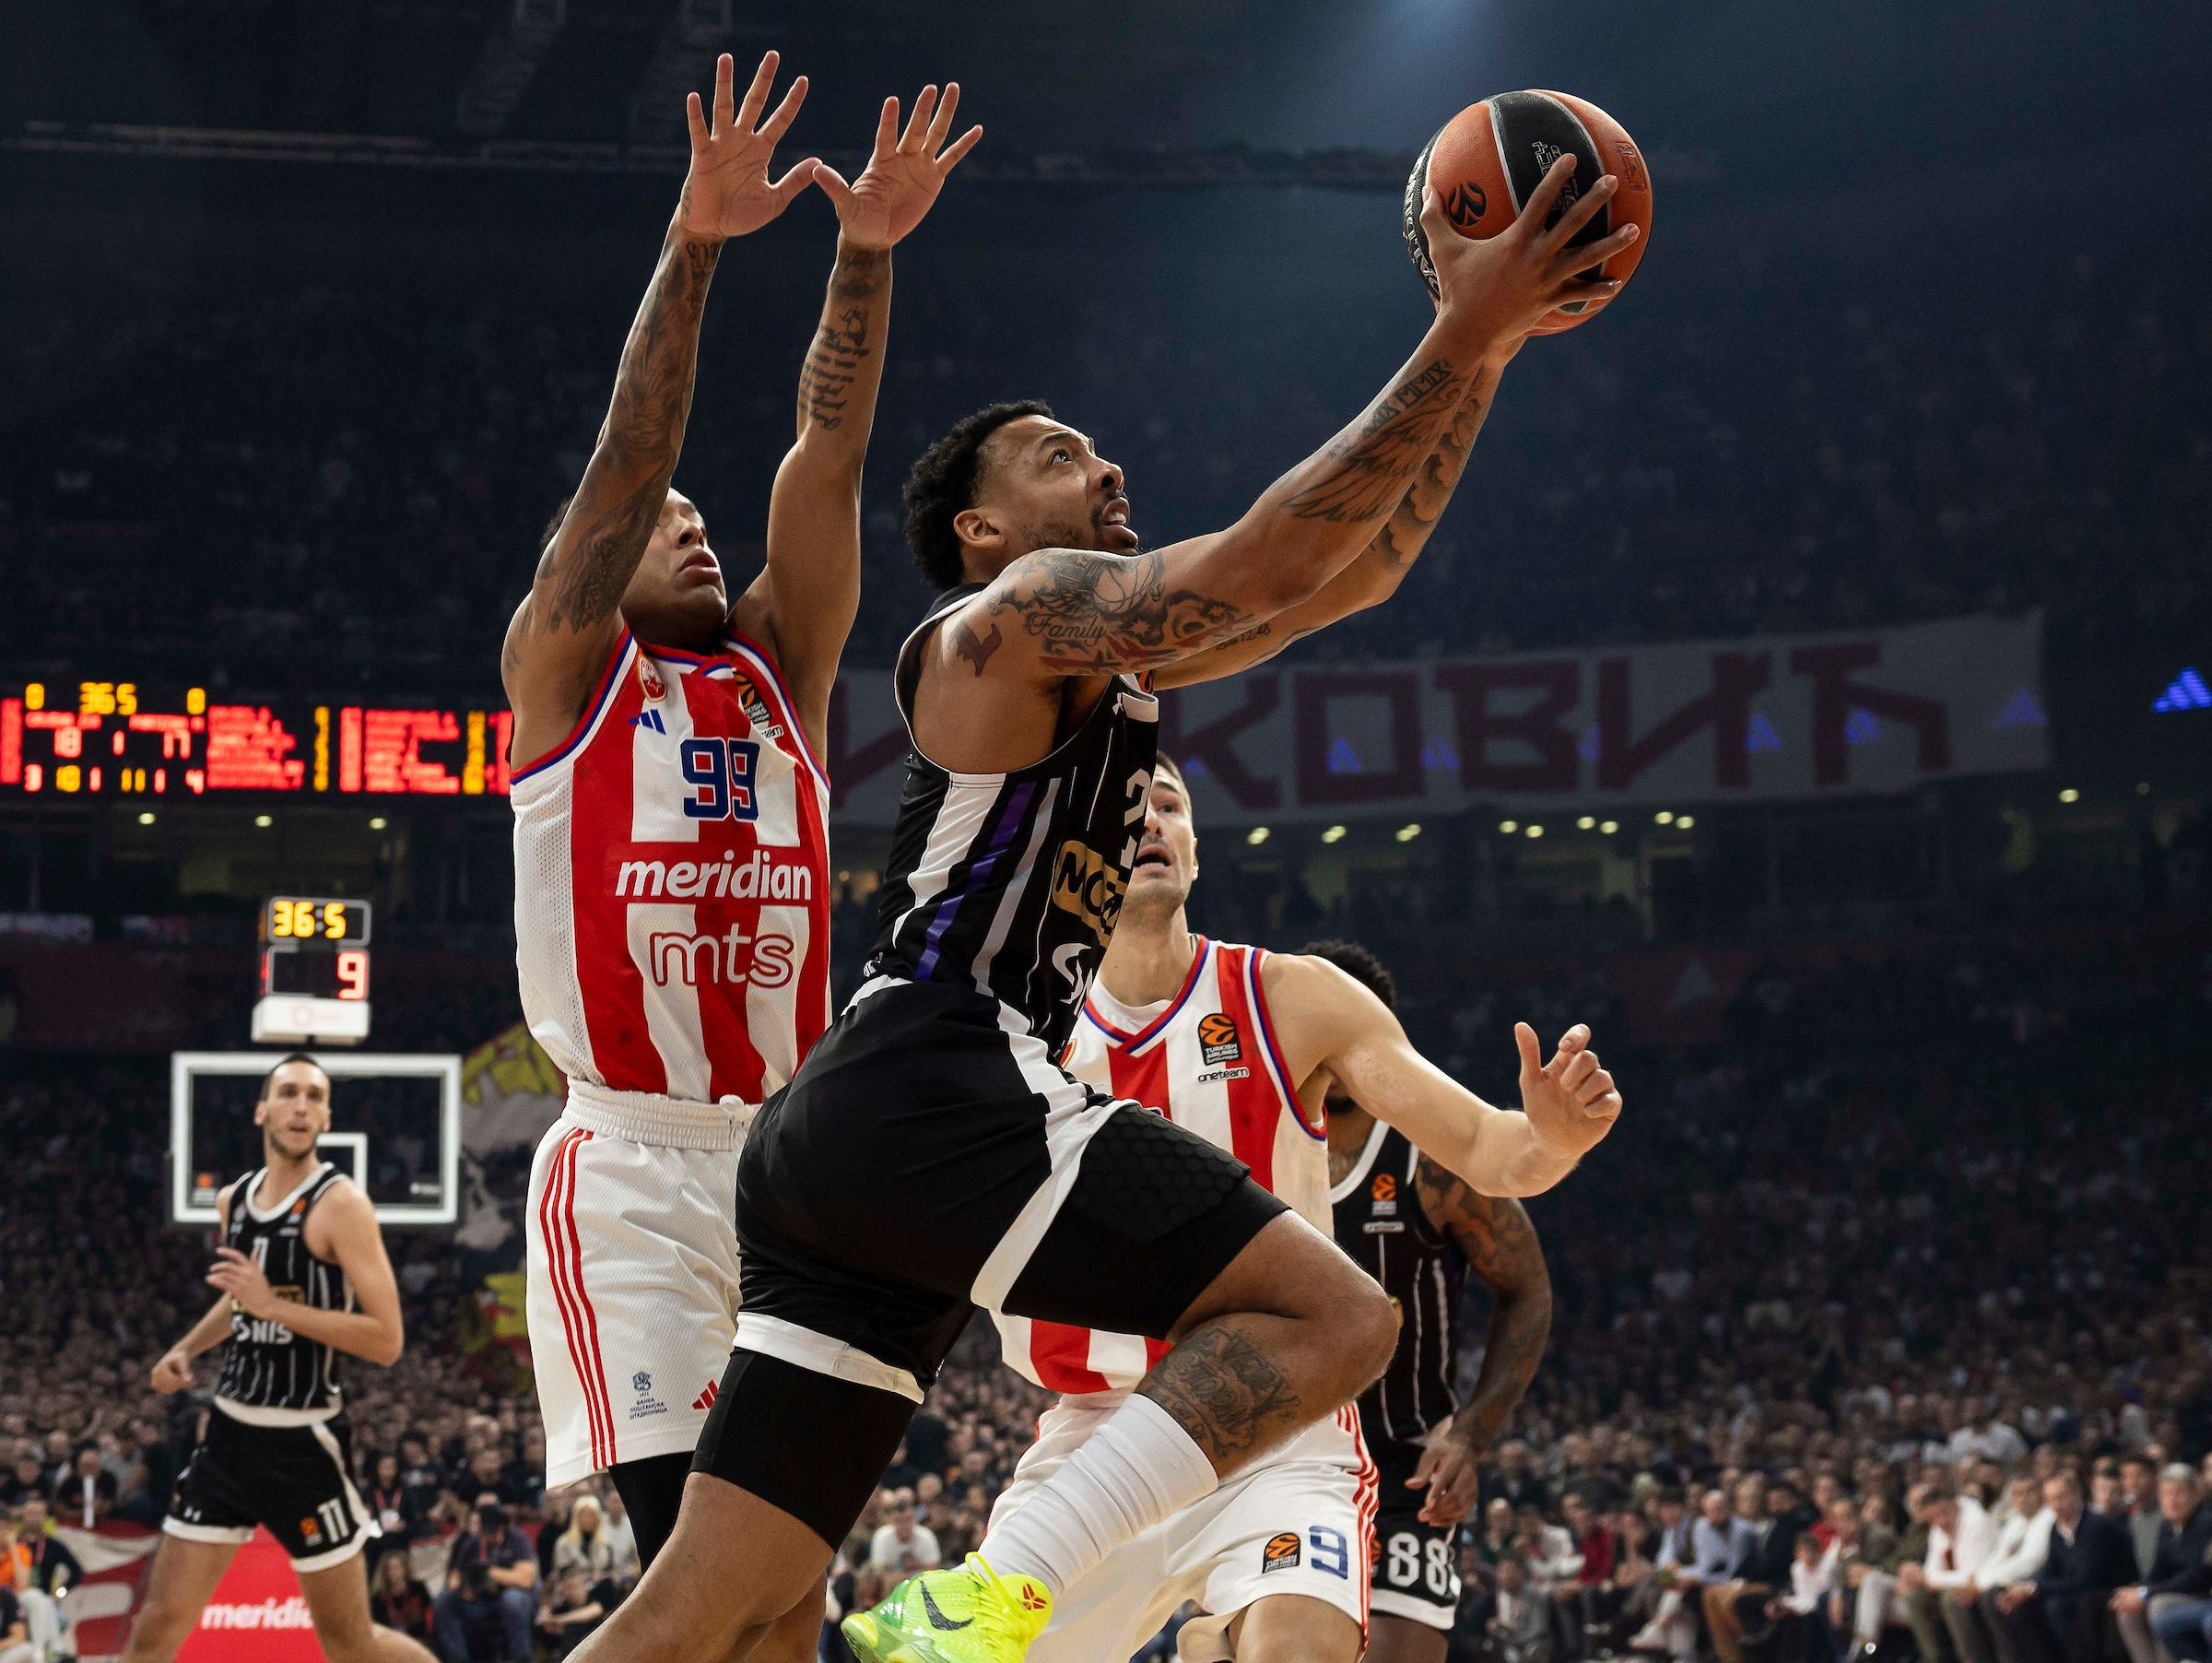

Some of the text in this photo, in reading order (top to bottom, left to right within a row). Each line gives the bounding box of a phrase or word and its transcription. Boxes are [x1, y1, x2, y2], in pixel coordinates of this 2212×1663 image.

[1028, 612, 1106, 646] Family
[680, 737, 760, 822] 99
[615, 849, 811, 901] meridian
[336, 950, 368, 1001] 9
[650, 922, 794, 987] mts
[1198, 1067, 1249, 1082] oneteam
[317, 1497, 349, 1544] 11
[1309, 1525, 1348, 1580] 9
[1387, 1531, 1448, 1597] 88
